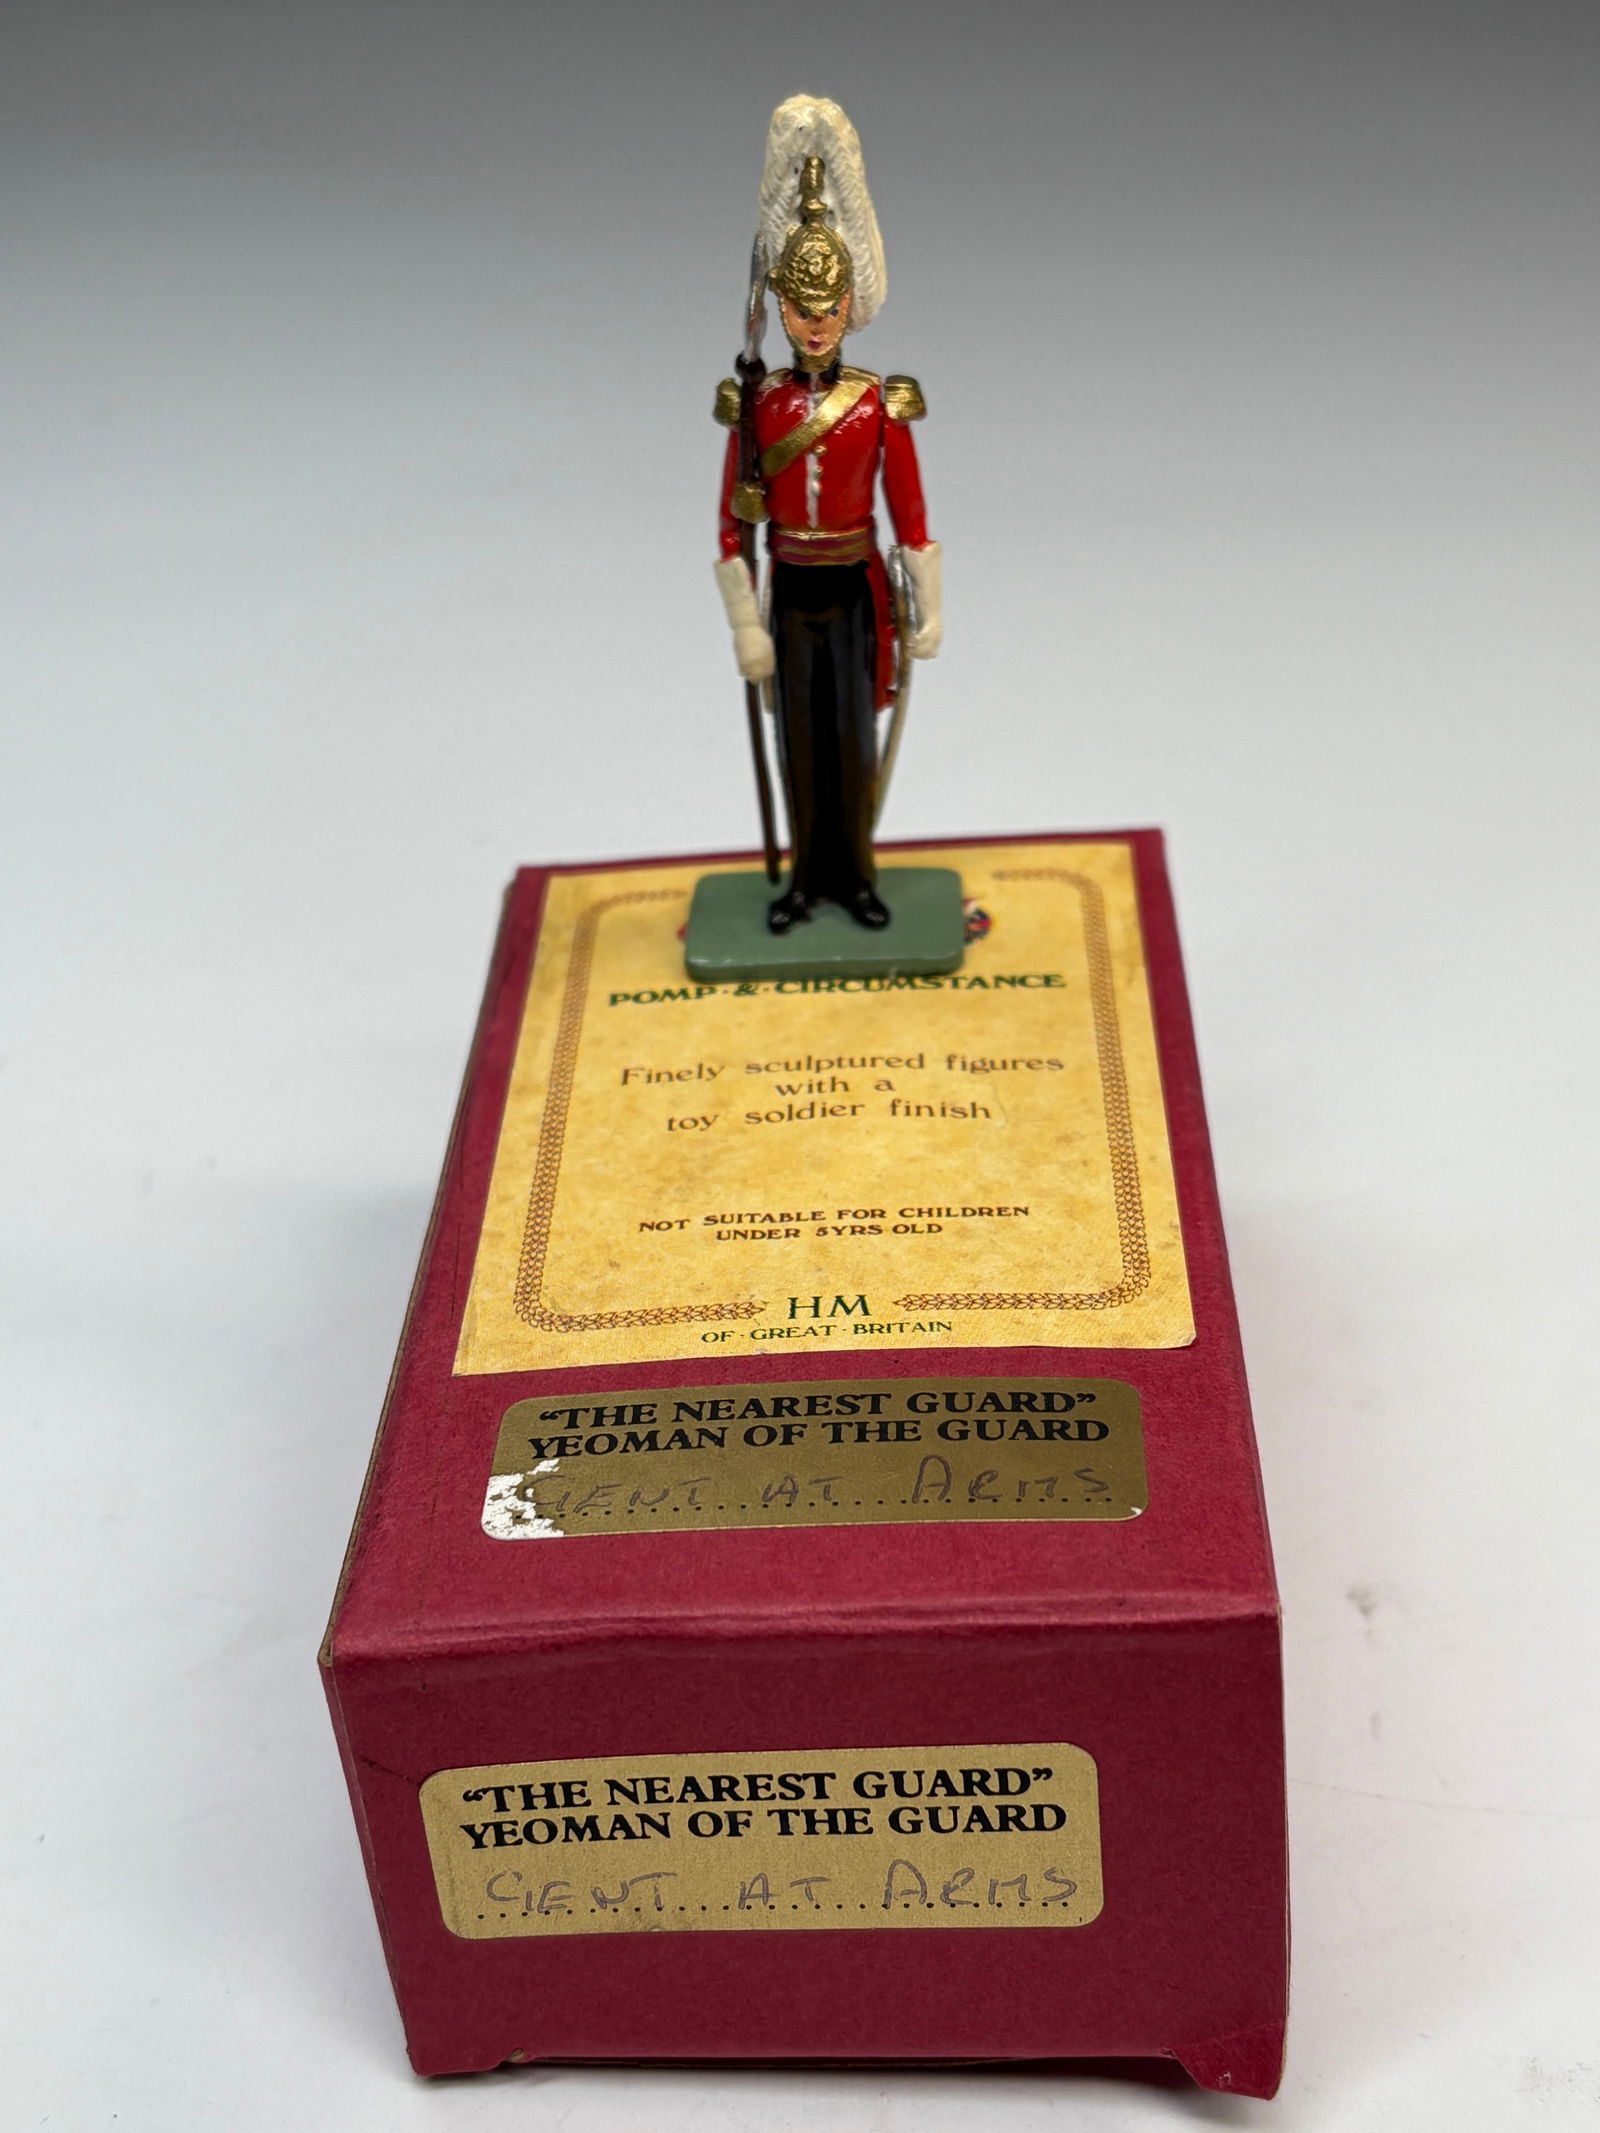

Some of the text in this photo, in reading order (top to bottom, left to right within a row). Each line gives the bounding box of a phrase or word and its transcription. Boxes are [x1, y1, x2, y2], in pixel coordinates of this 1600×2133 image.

[620, 1053, 1064, 1086] Finely sculptured figures
[775, 1076, 896, 1097] with a
[666, 1098, 992, 1132] toy soldier finish
[639, 1206, 1029, 1233] NOT SUITABLE FOR CHILDREN
[715, 1223, 943, 1241] UNDER 5YRS OLD
[787, 1294, 872, 1320] HM
[671, 1394, 892, 1422] NEAREST
[528, 1419, 1109, 1459] YEOMAN OF THE GUARD
[763, 1475, 842, 1504] AT
[604, 1772, 836, 1806] NEAREST
[460, 1803, 1067, 1850] YEOMAN OF THE GUARD
[737, 1872, 830, 1910] AT
